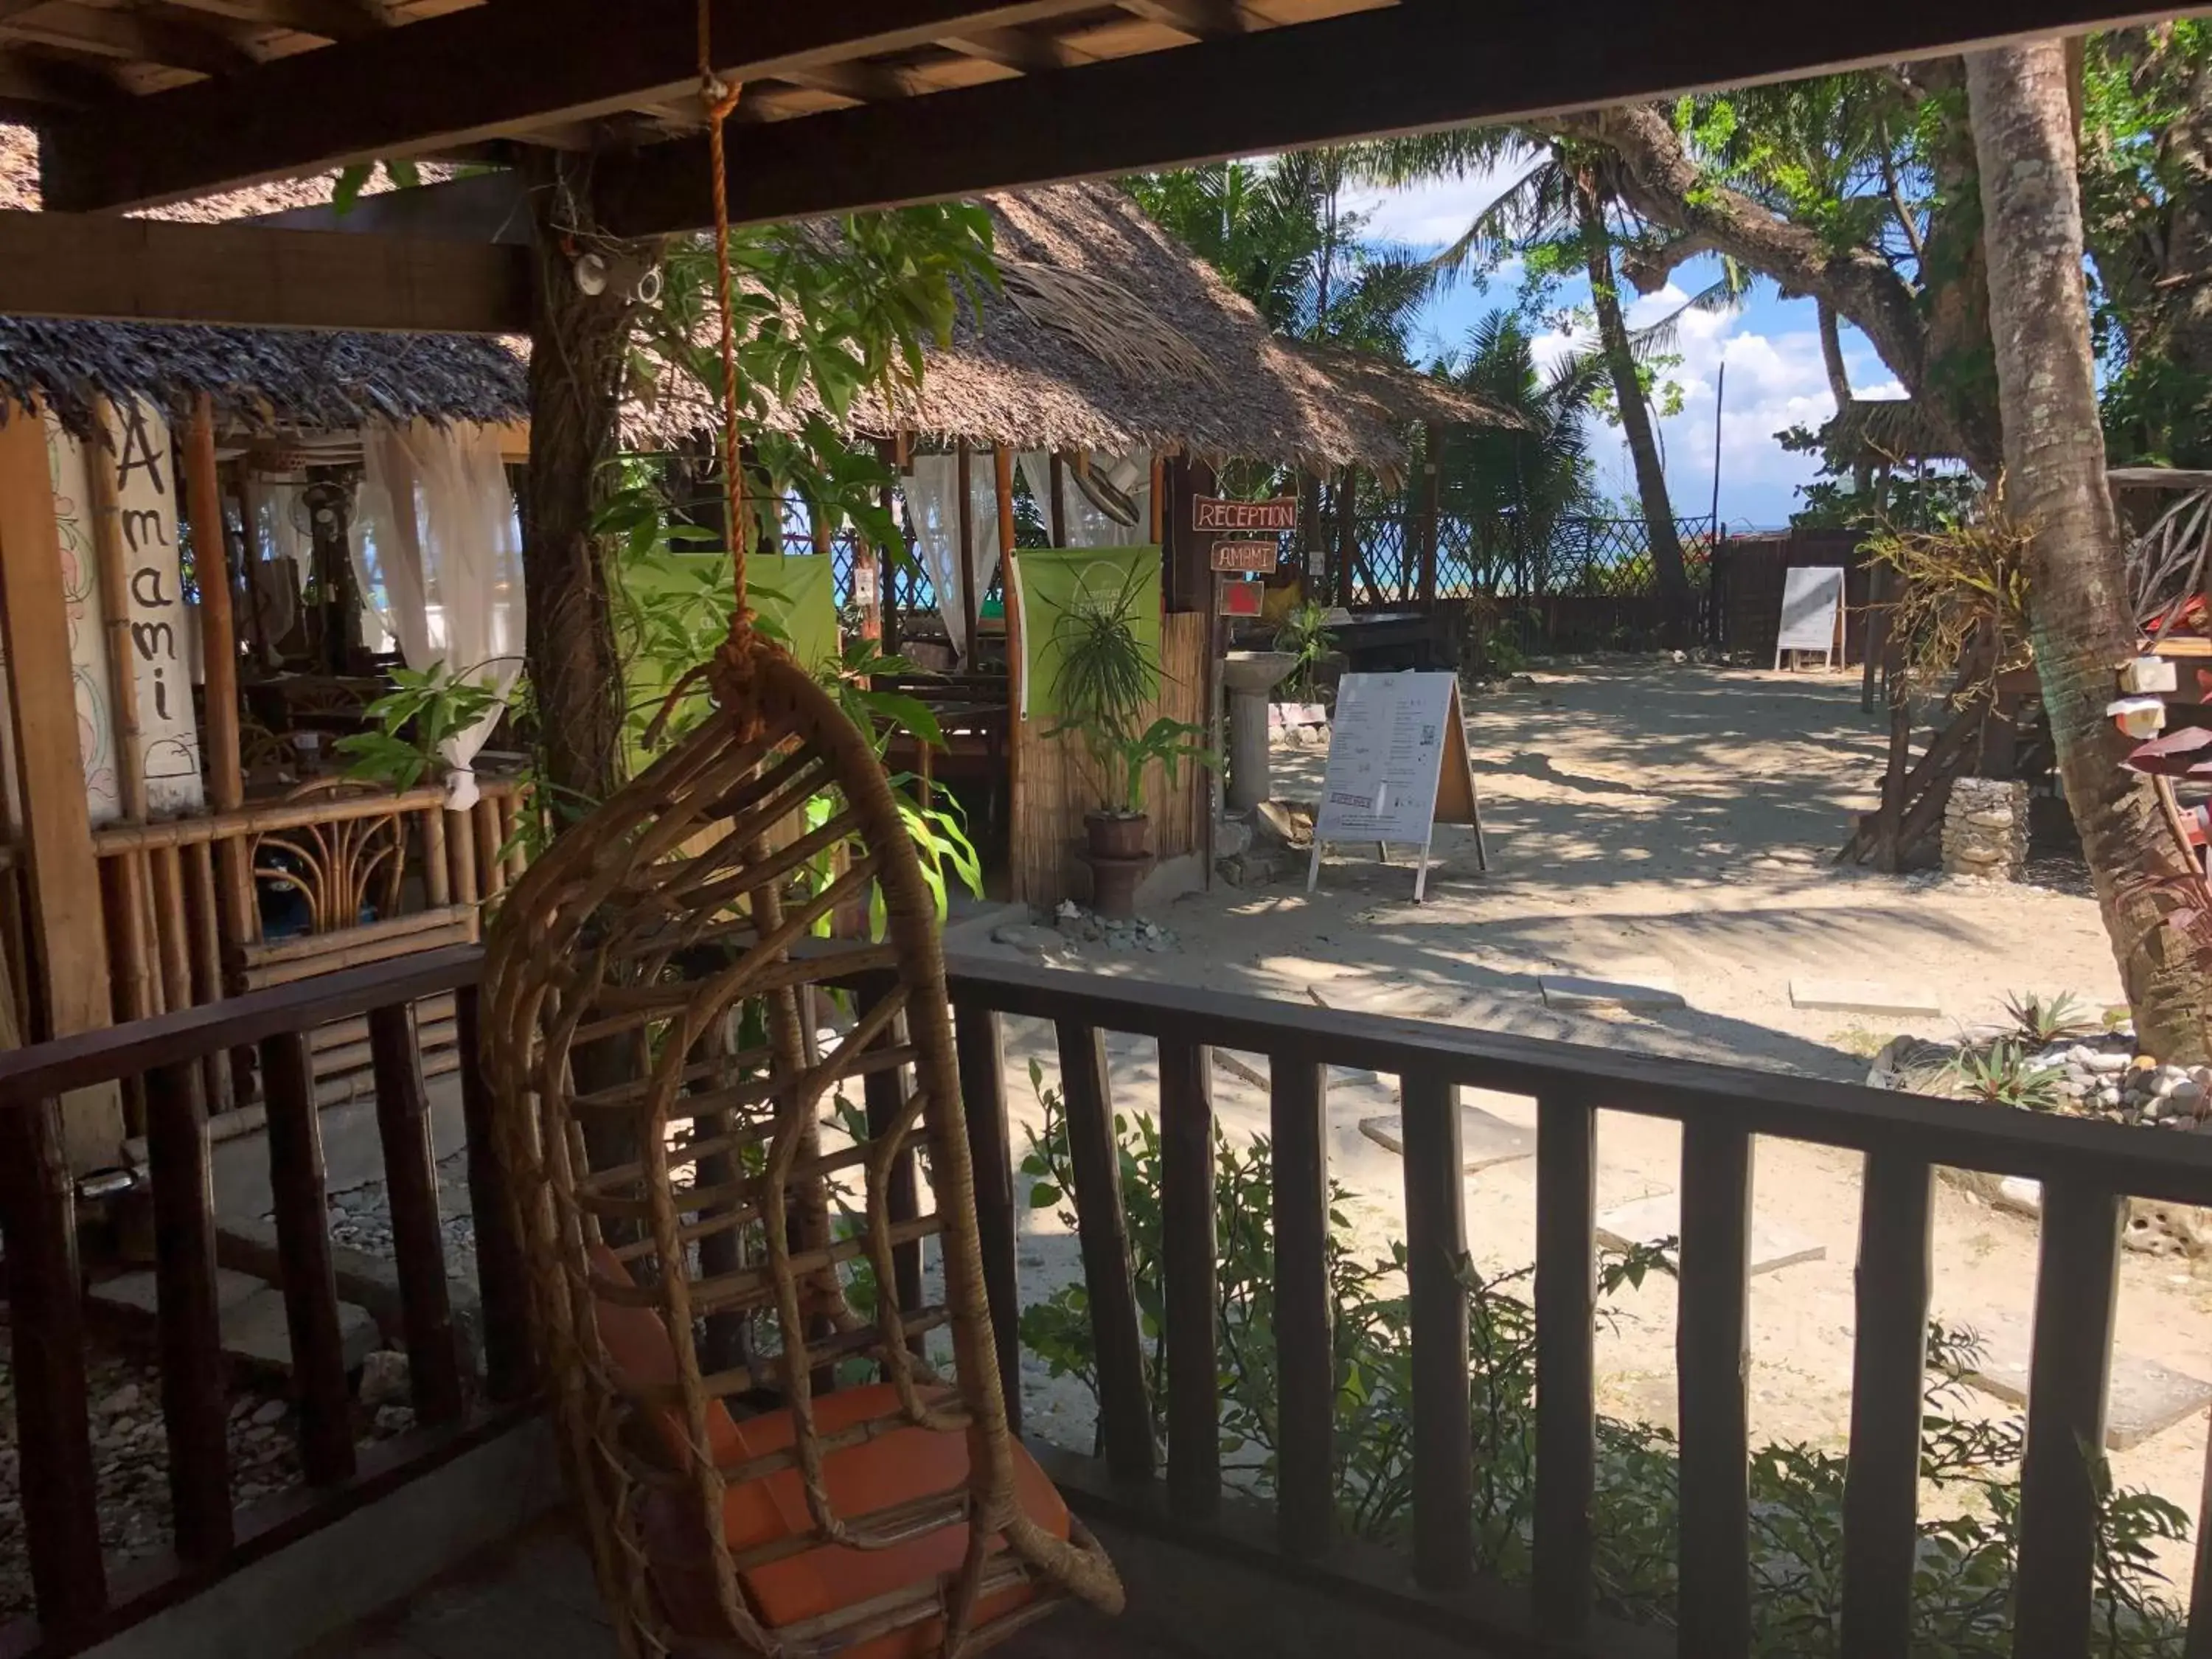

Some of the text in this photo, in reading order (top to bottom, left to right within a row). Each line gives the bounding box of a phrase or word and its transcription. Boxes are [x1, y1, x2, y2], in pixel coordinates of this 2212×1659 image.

[1199, 504, 1293, 527] RECEPTION
[116, 395, 176, 720] Amami
[1219, 547, 1270, 567] AMAMI
